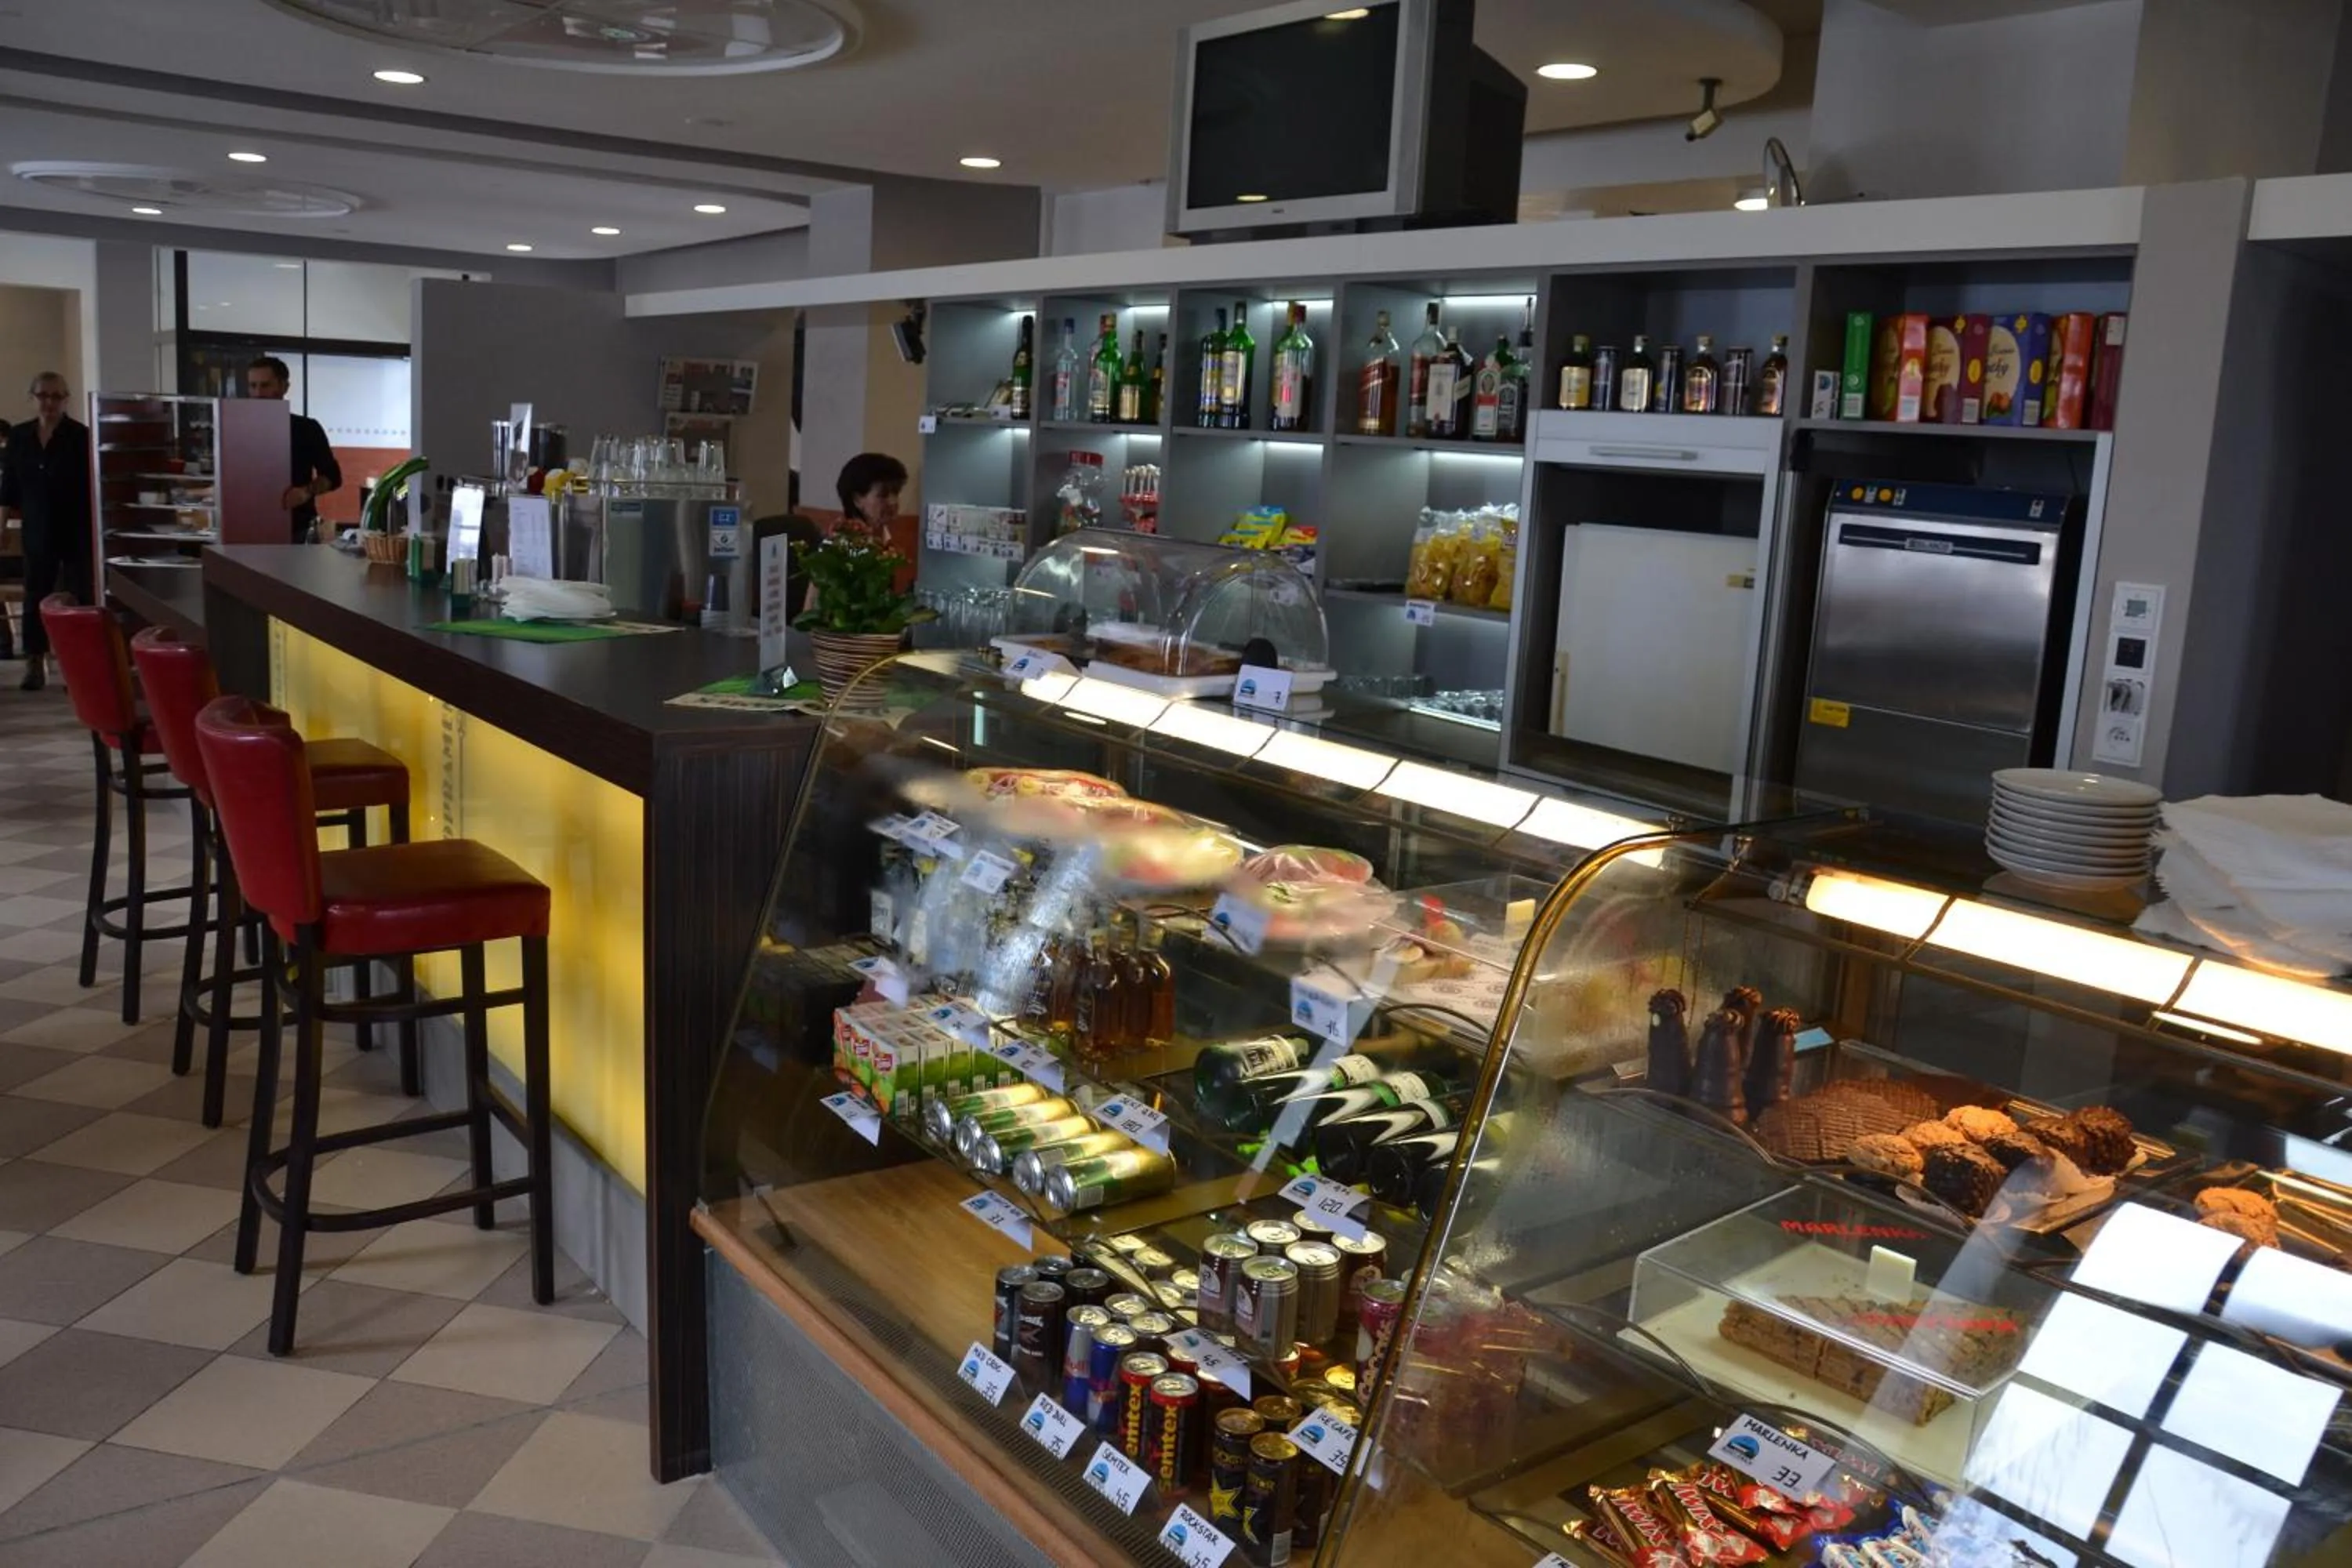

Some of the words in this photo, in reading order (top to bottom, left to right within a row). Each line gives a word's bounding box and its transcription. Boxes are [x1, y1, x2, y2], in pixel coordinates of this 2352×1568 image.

[1319, 1197, 1344, 1214] 120
[1125, 1383, 1142, 1457] emtex
[1744, 1419, 1809, 1461] MARLENKA
[1103, 1448, 1131, 1475] SEMTEX
[1772, 1465, 1802, 1488] 33
[1180, 1508, 1220, 1545] ROCKSTAR
